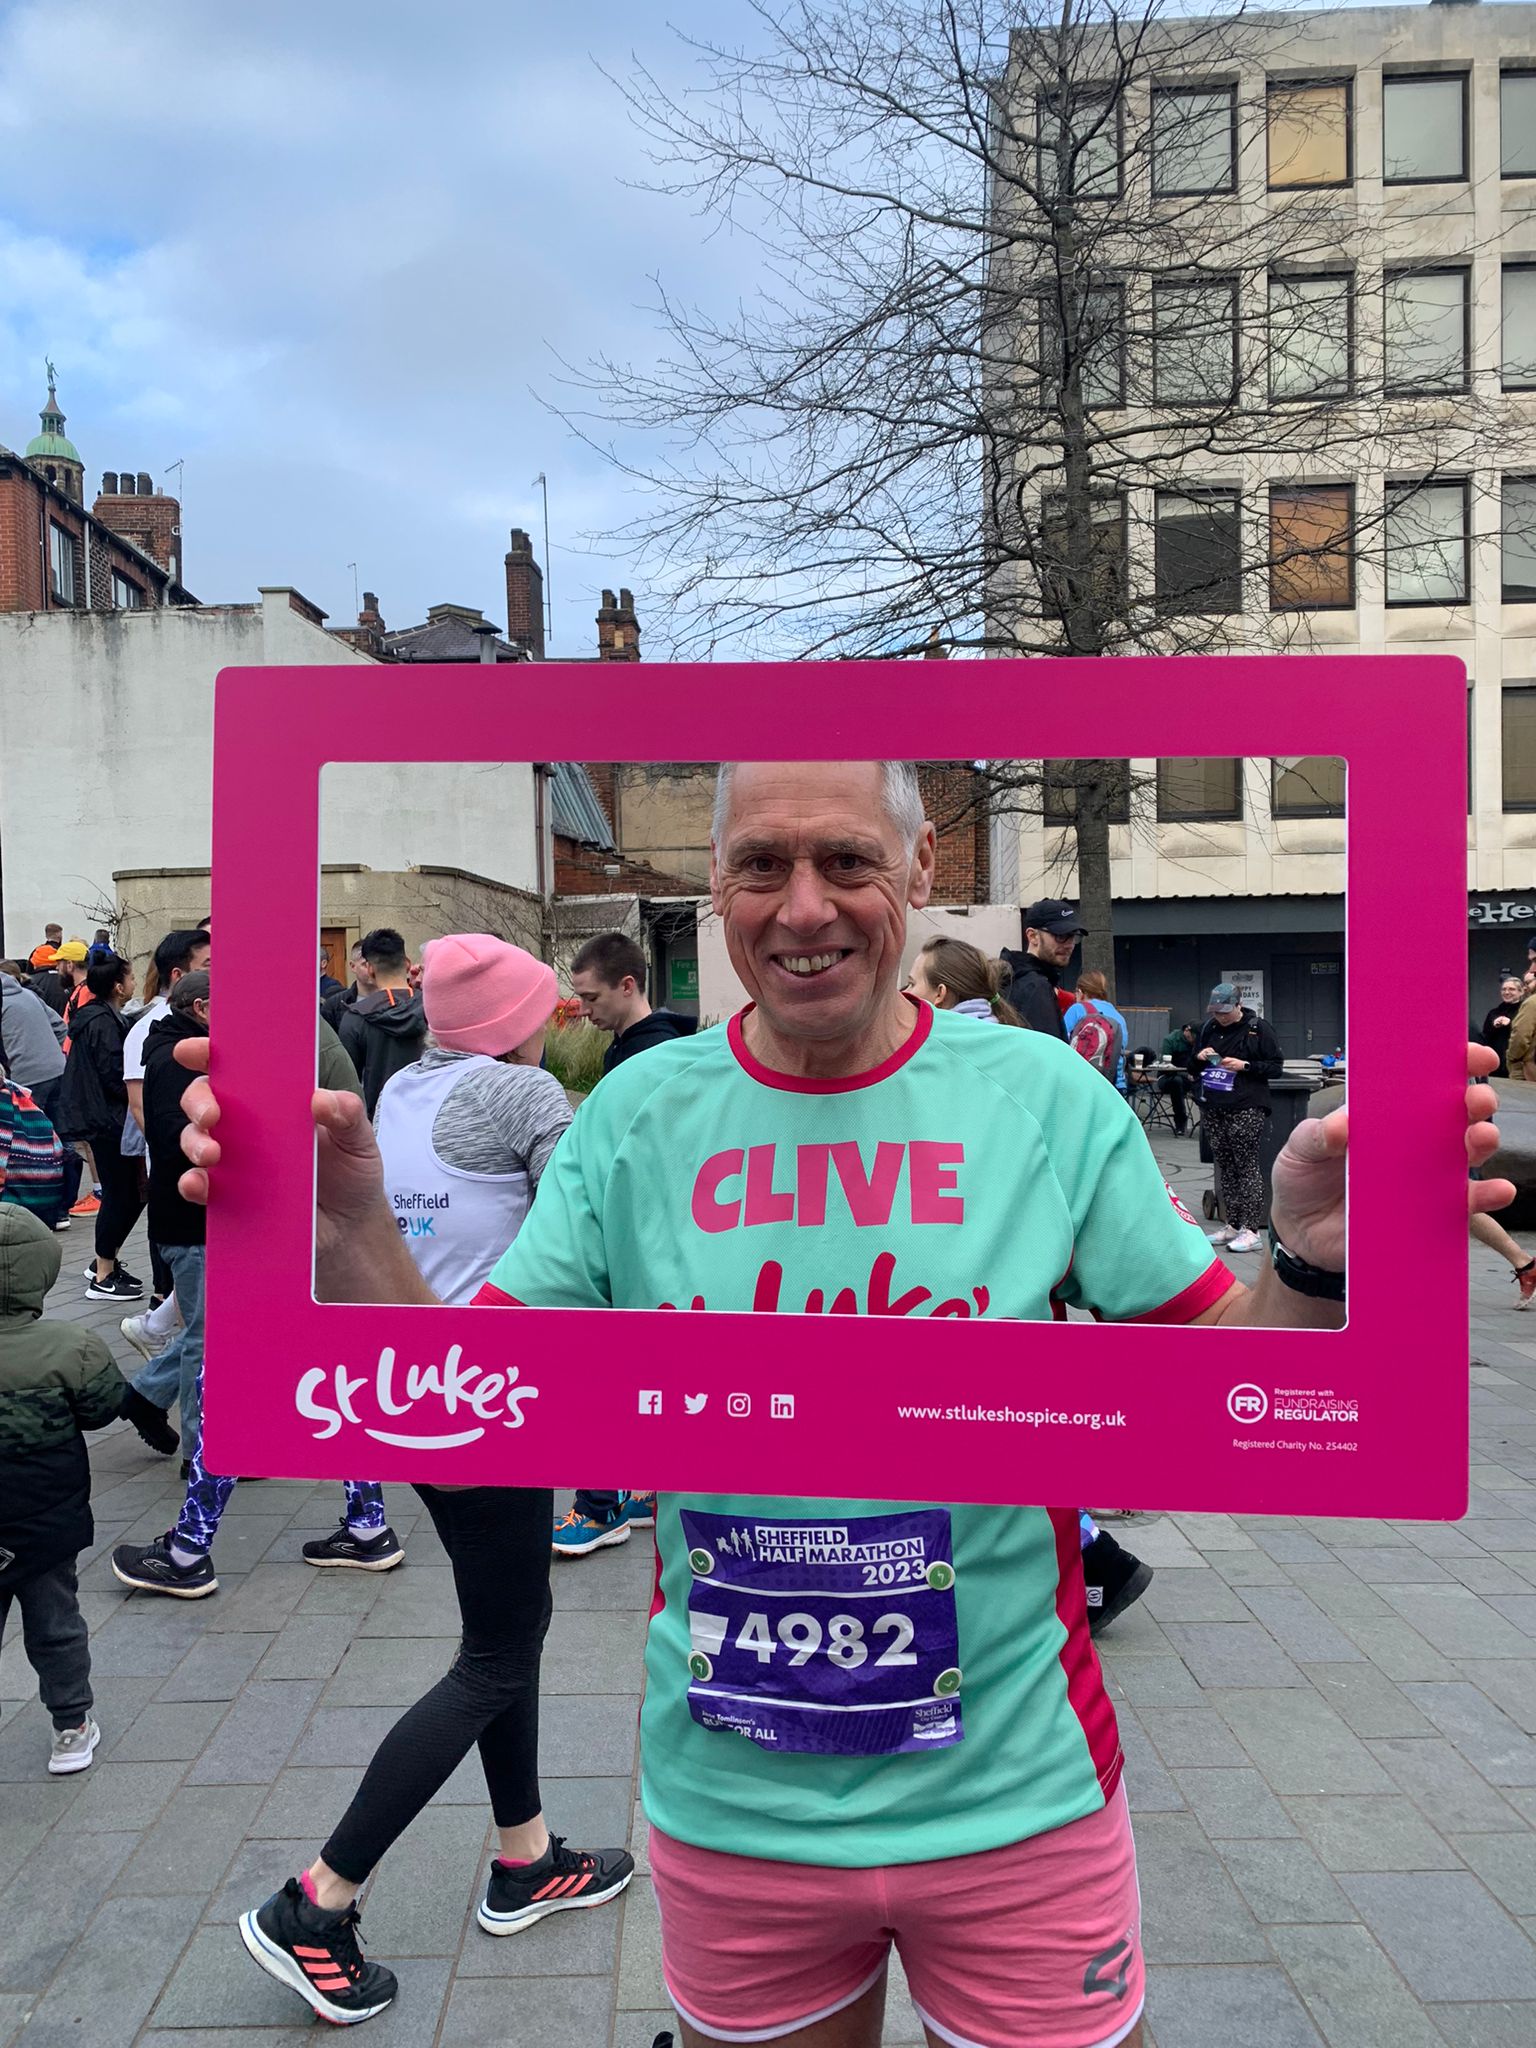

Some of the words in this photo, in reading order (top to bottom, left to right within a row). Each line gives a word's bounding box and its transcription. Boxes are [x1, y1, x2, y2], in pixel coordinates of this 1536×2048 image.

[691, 1141, 965, 1234] CLIVE
[394, 1193, 449, 1209] Sheffield
[397, 1216, 436, 1236] eUK
[295, 1364, 369, 1440] St
[376, 1344, 539, 1428] Luke's
[1274, 1388, 1316, 1397] Registered
[1317, 1389, 1334, 1397] with
[1234, 1396, 1261, 1412] FR
[1274, 1398, 1358, 1410] FUNDRAISING
[897, 1404, 1127, 1430] www.stlukeshospice.org.uk
[1274, 1409, 1359, 1422] REGULATOR
[1233, 1439, 1275, 1450] Registered
[1276, 1440, 1307, 1452] Charity
[1309, 1442, 1325, 1450] No.
[1326, 1442, 1358, 1451] 254402
[756, 1529, 846, 1546] SHEFFIELD
[759, 1547, 804, 1563] HALF
[808, 1538, 923, 1565] MARATHON
[861, 1559, 926, 1586] 2023
[735, 1611, 918, 1669] 4982
[754, 1728, 778, 1741] ALL
